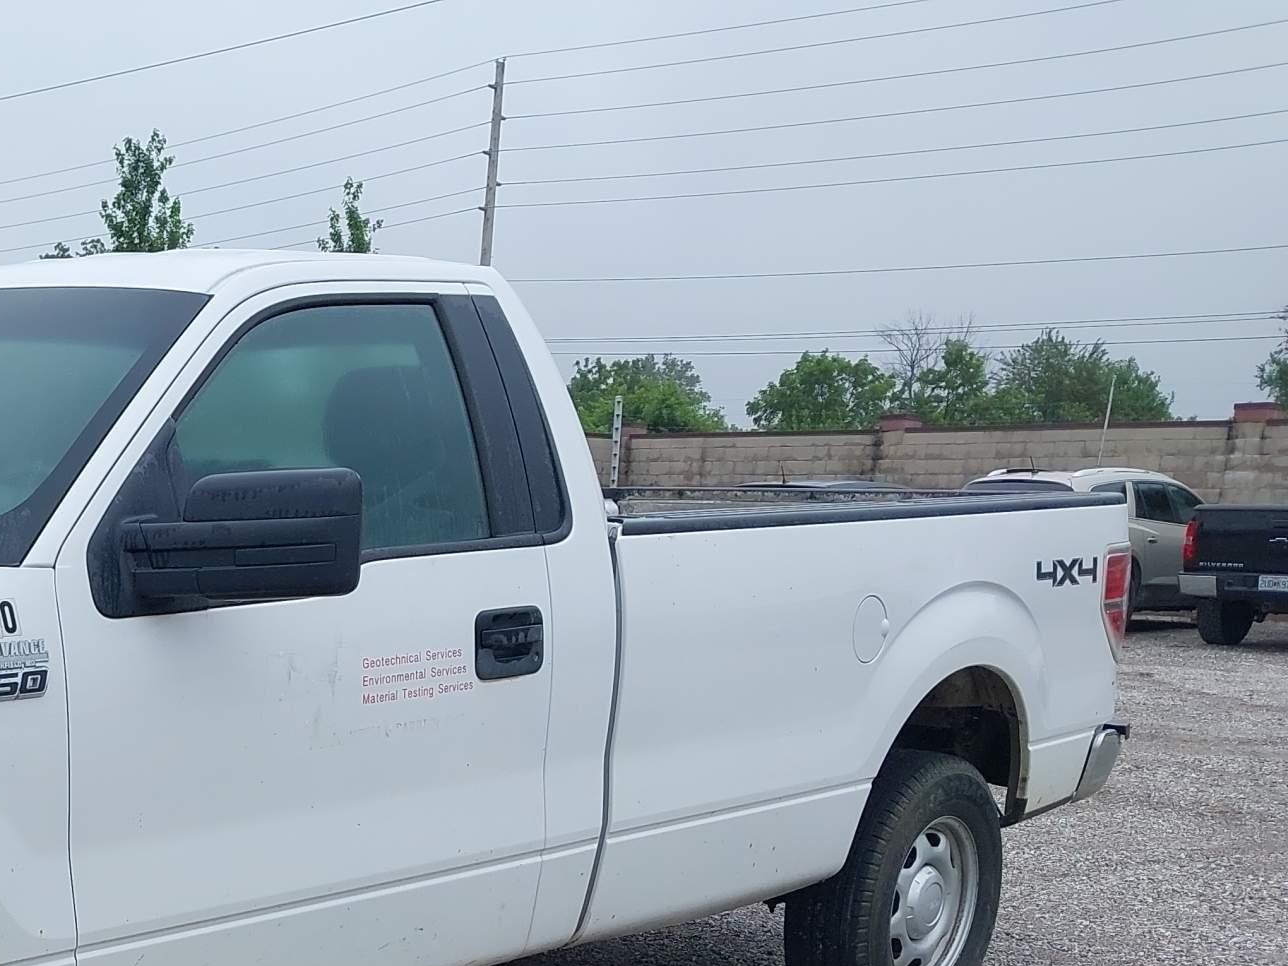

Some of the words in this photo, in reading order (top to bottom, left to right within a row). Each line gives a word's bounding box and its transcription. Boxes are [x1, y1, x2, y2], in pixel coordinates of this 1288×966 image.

[1036, 556, 1098, 587] 4X4
[0, 639, 45, 657] VANCE
[362, 651, 422, 668] Geotechnical
[425, 648, 462, 661] Services
[362, 669, 426, 686] Environmental
[431, 664, 467, 678] Services
[362, 690, 398, 704] Material
[402, 687, 434, 698] Testing
[438, 680, 474, 694] Services
